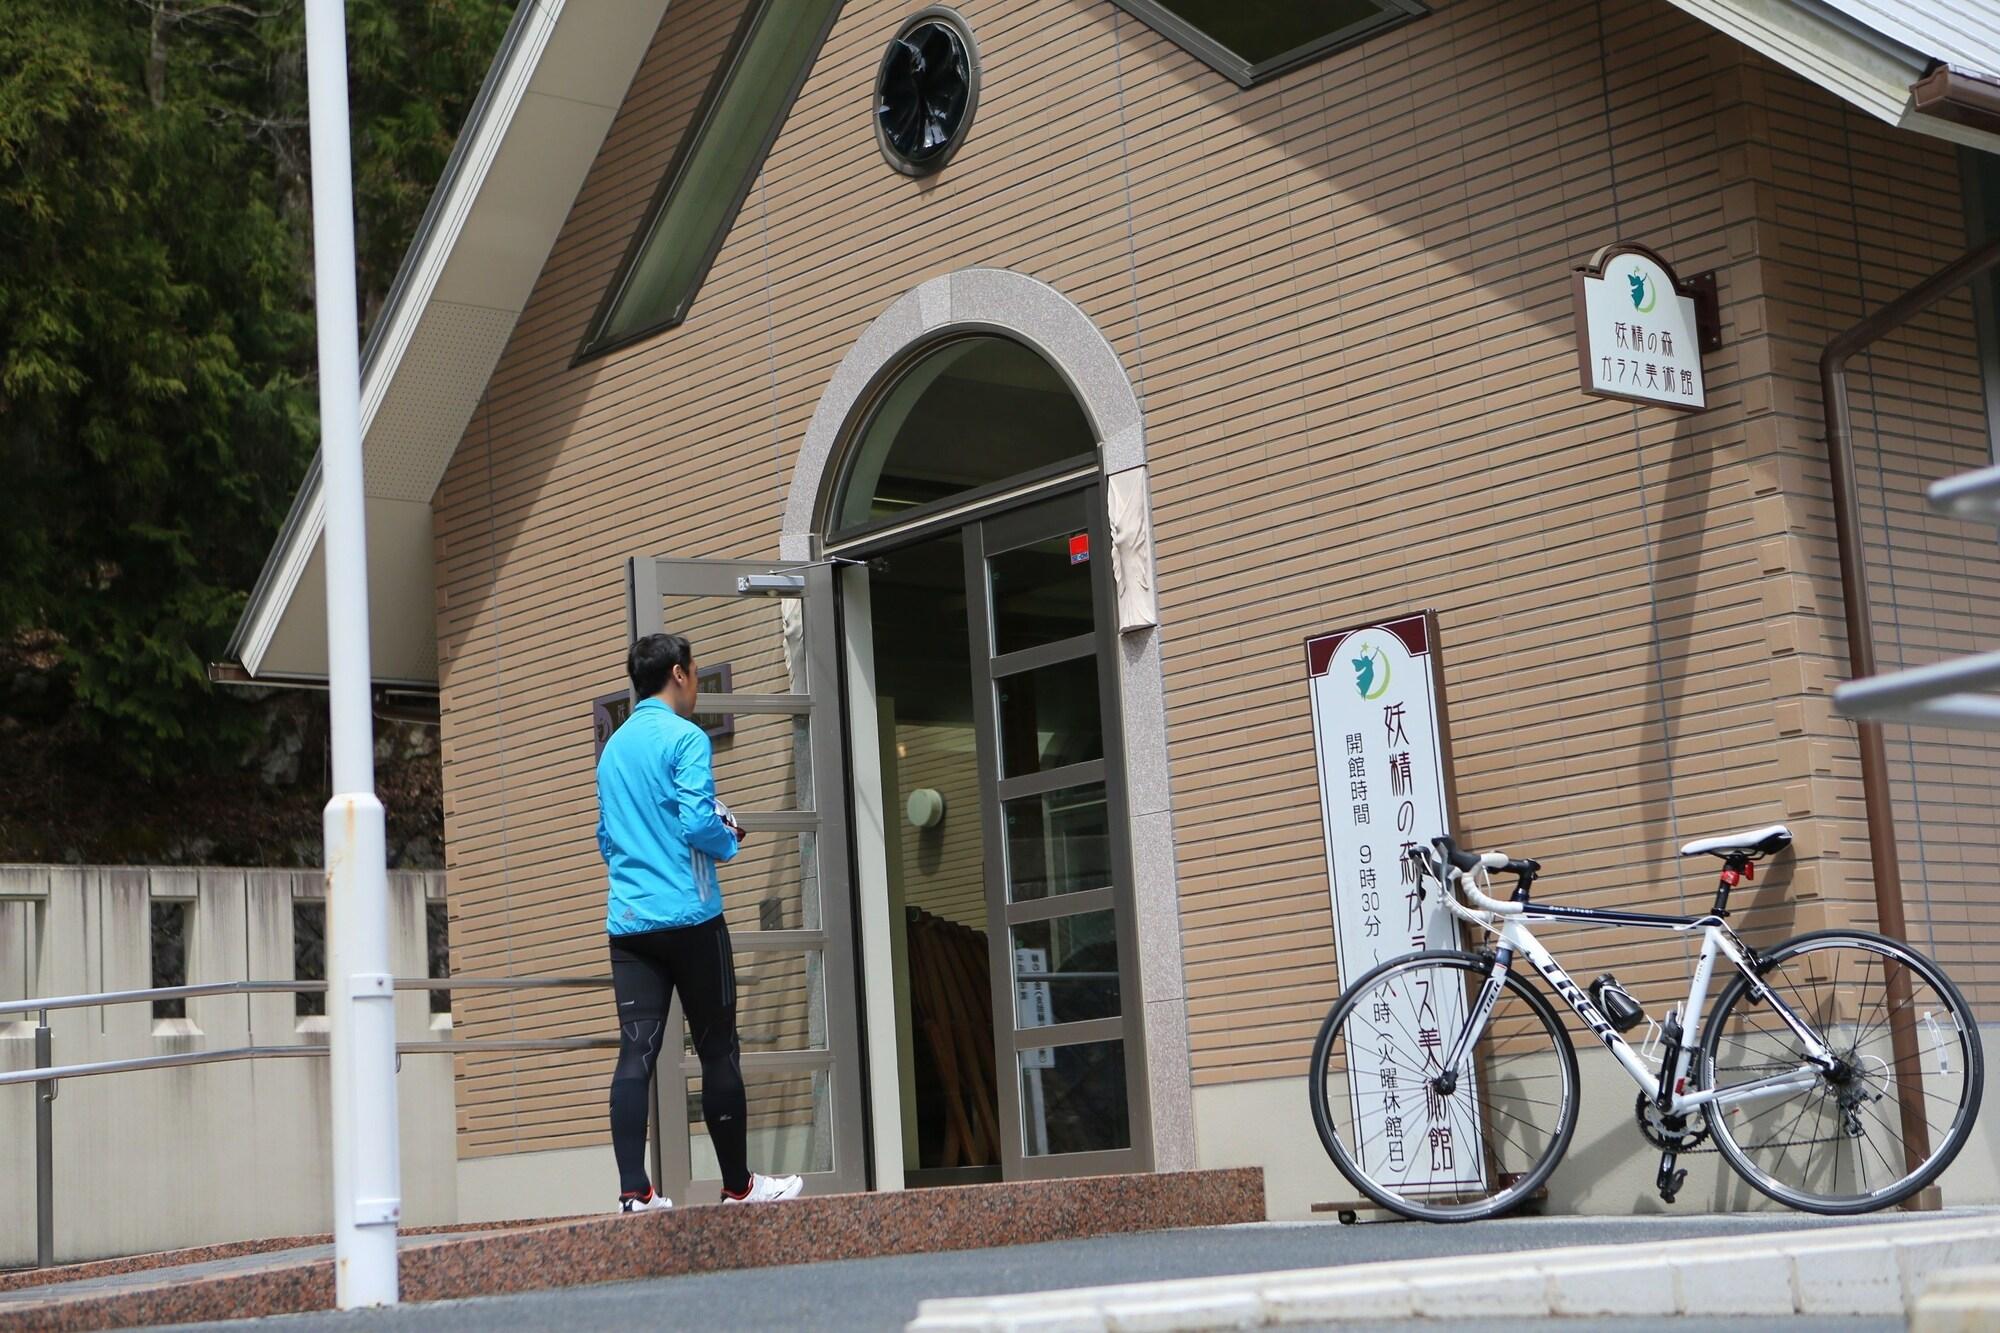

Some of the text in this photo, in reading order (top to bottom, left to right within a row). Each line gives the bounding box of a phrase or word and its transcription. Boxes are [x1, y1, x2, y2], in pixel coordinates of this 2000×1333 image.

[1614, 321, 1674, 357] 妖精の森
[1601, 355, 1694, 395] ガラス美術館
[1345, 732, 1371, 826] 開館時間
[1543, 955, 1624, 1050] TREK
